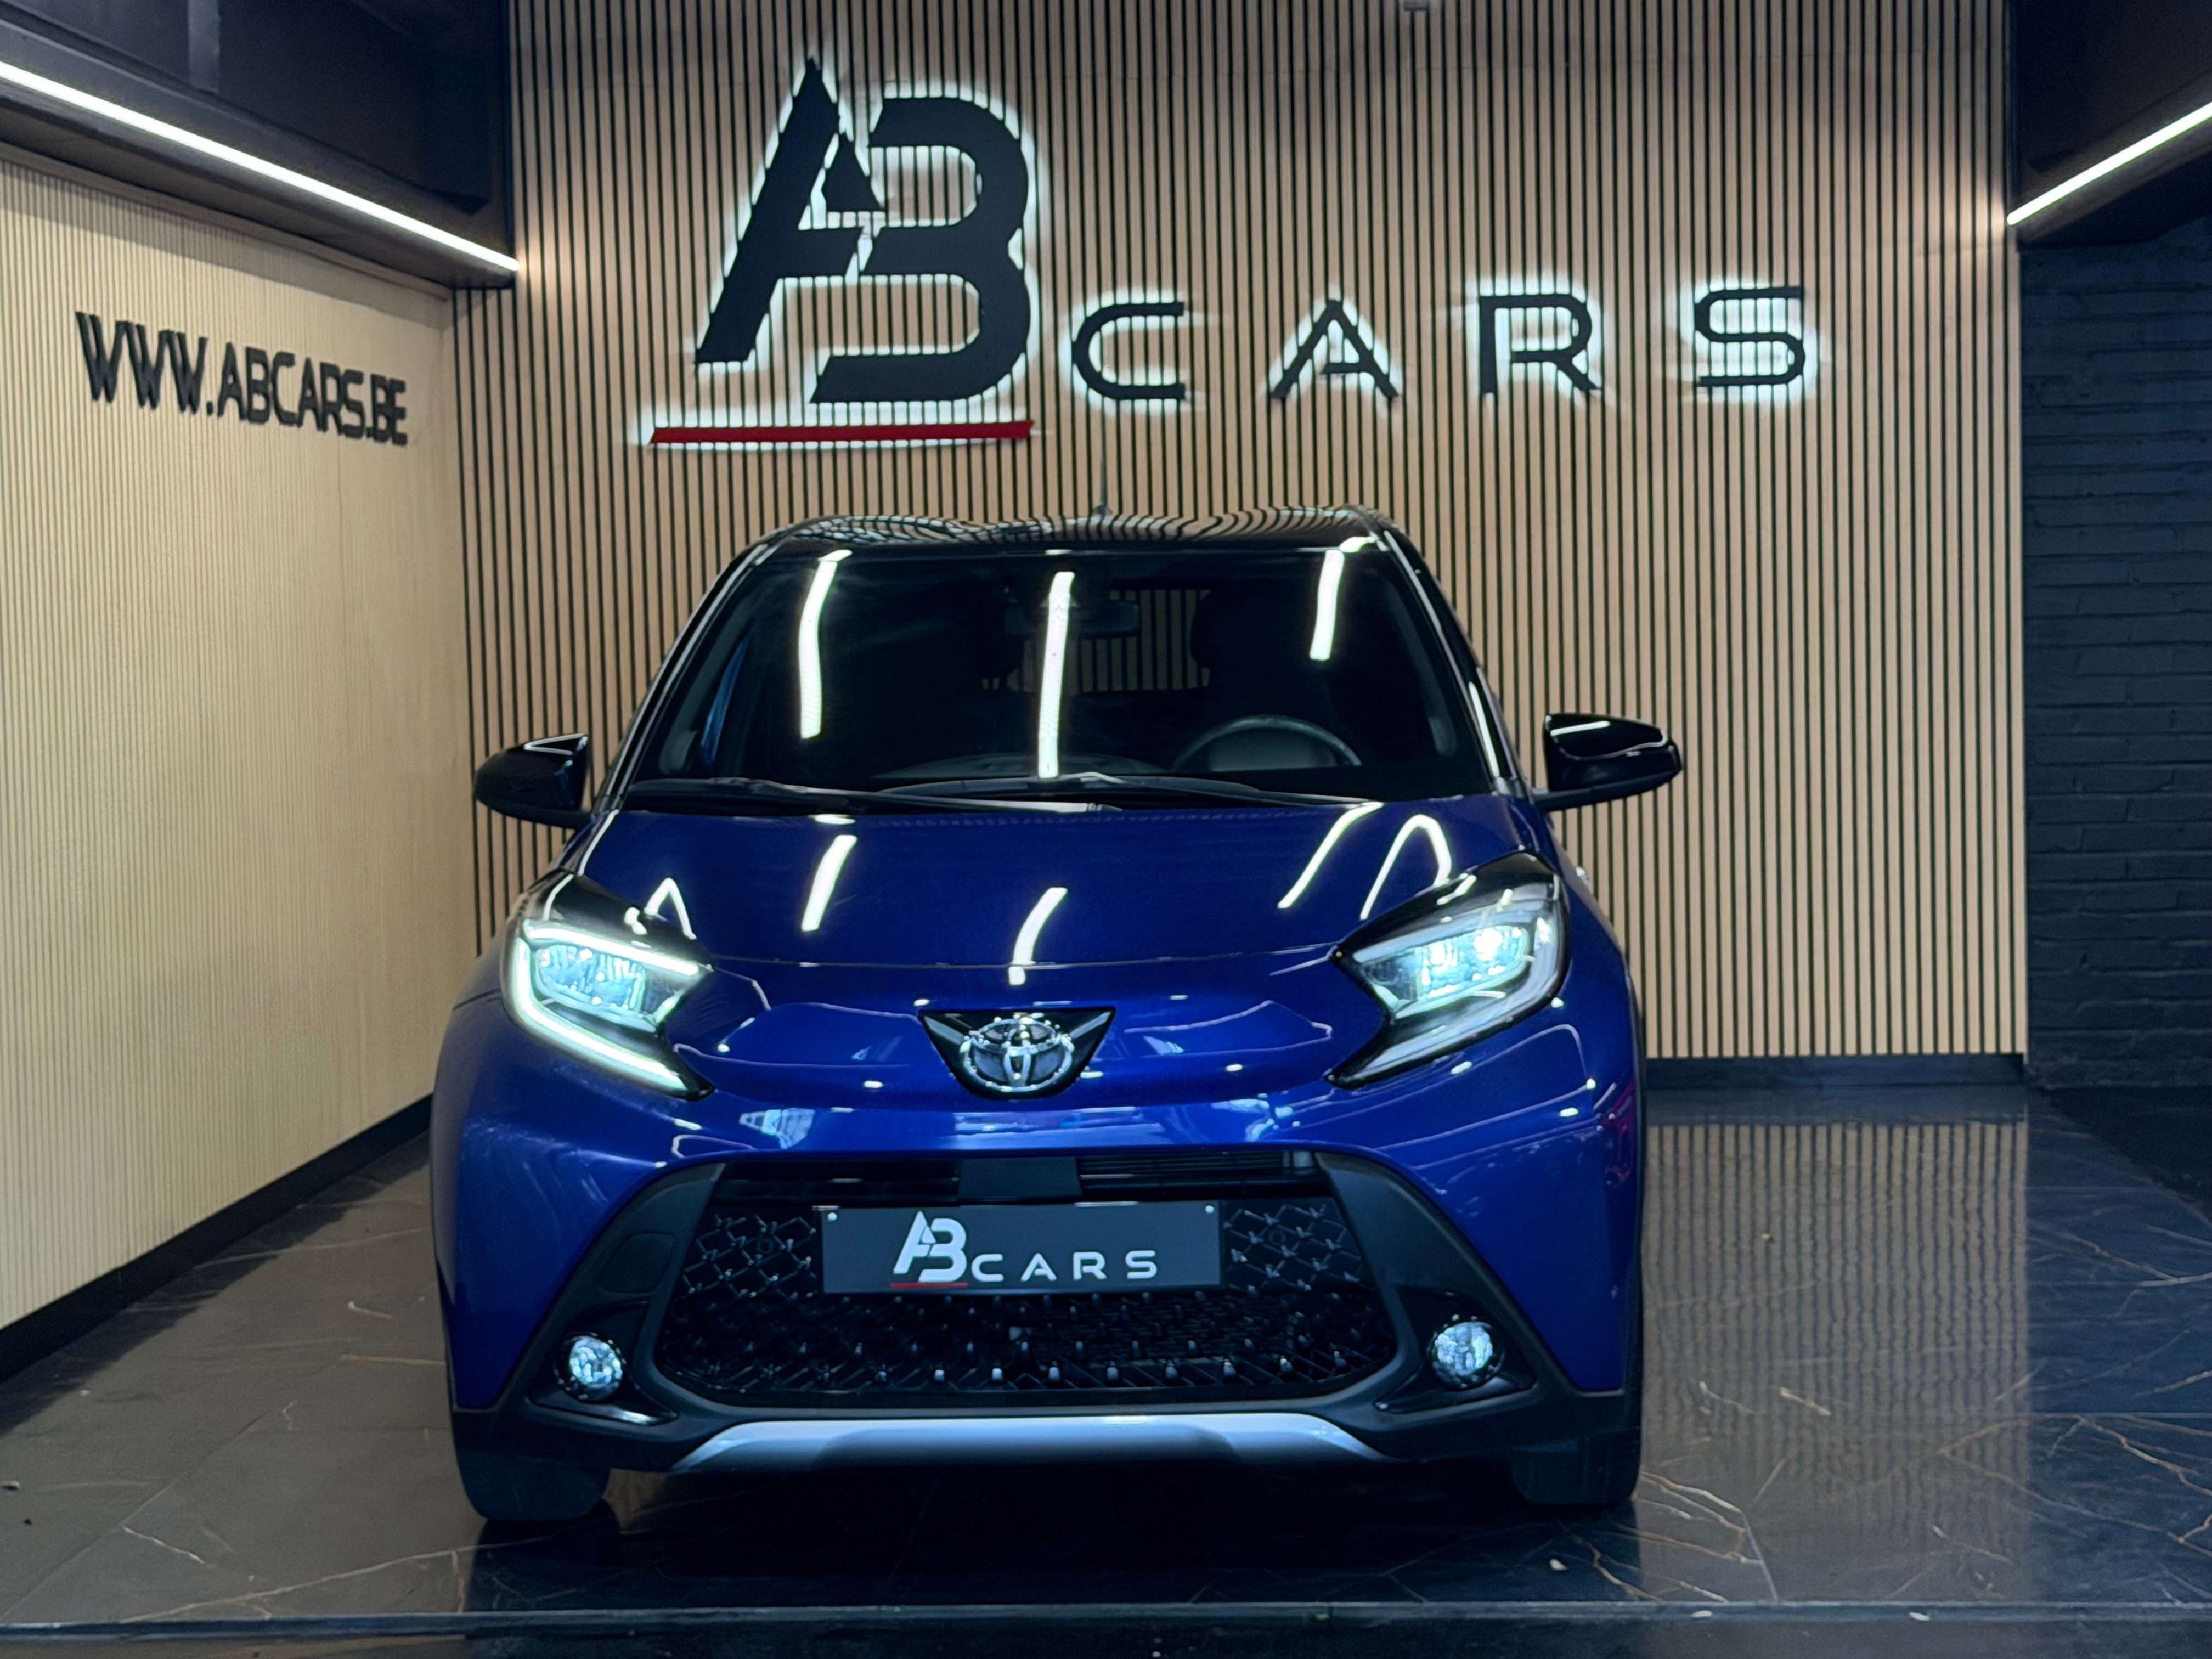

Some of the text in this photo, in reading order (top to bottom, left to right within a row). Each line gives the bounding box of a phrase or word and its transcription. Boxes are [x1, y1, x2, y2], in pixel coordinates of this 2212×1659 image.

[695, 57, 1806, 403] AB CARS
[75, 311, 408, 446] WWW.ABCARS.BE
[893, 1211, 1158, 1283] AB CARS
